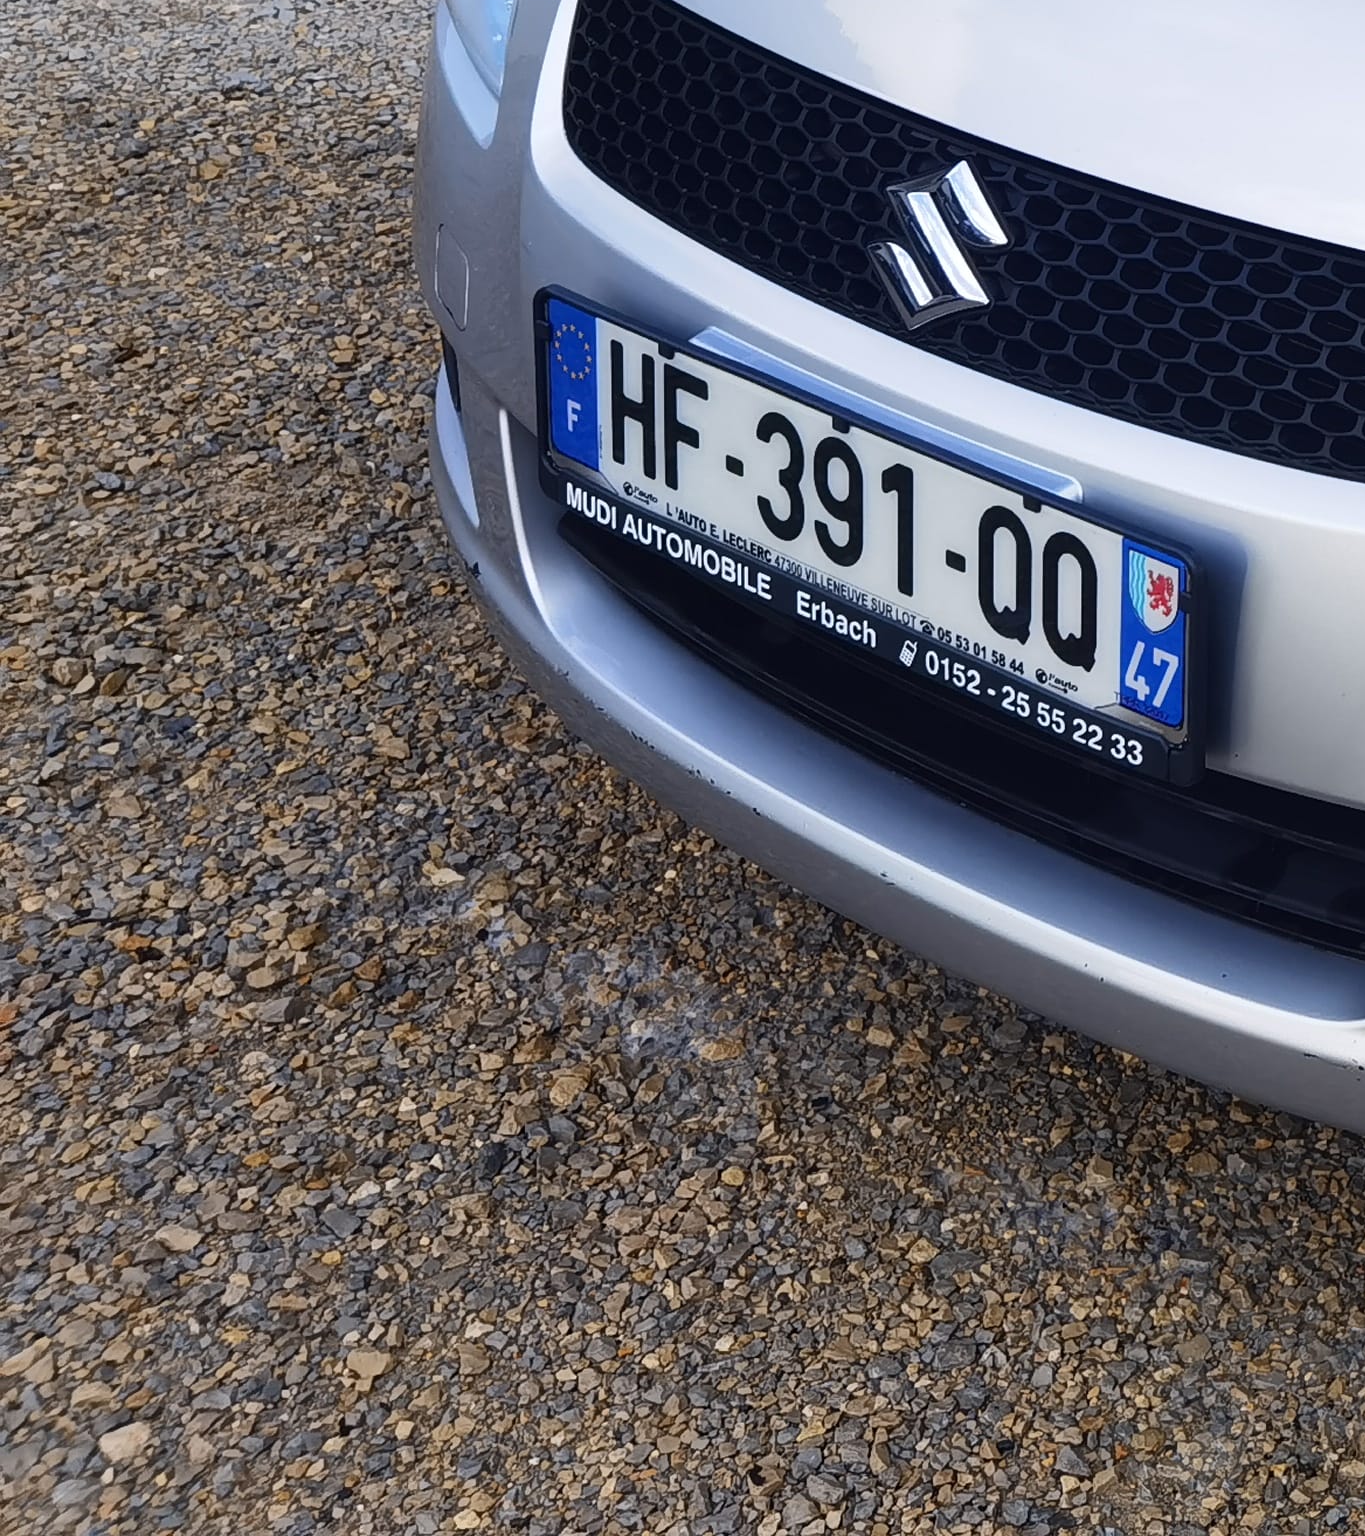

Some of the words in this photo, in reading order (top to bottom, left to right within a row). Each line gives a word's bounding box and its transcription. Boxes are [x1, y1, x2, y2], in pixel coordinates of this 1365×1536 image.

[566, 398, 582, 433] F
[610, 339, 1098, 673] HF-391-QQ
[565, 481, 618, 530] MUDI
[622, 513, 773, 601] AUTOMOBILE
[796, 589, 877, 649] Erbach
[925, 650, 982, 696] 0152
[1001, 684, 1031, 718] 25
[1037, 701, 1066, 735] 55
[1072, 717, 1103, 751] 22
[1109, 733, 1144, 766] 33
[723, 528, 773, 564] LECLERC
[774, 554, 803, 578] 47300
[805, 568, 869, 607] VILLENEUVE
[870, 599, 893, 620] SUR
[937, 626, 953, 644] 05
[956, 635, 970, 652] 53
[973, 642, 987, 660] 01
[1009, 658, 1025, 676] 44
[1124, 639, 1180, 709] 47
